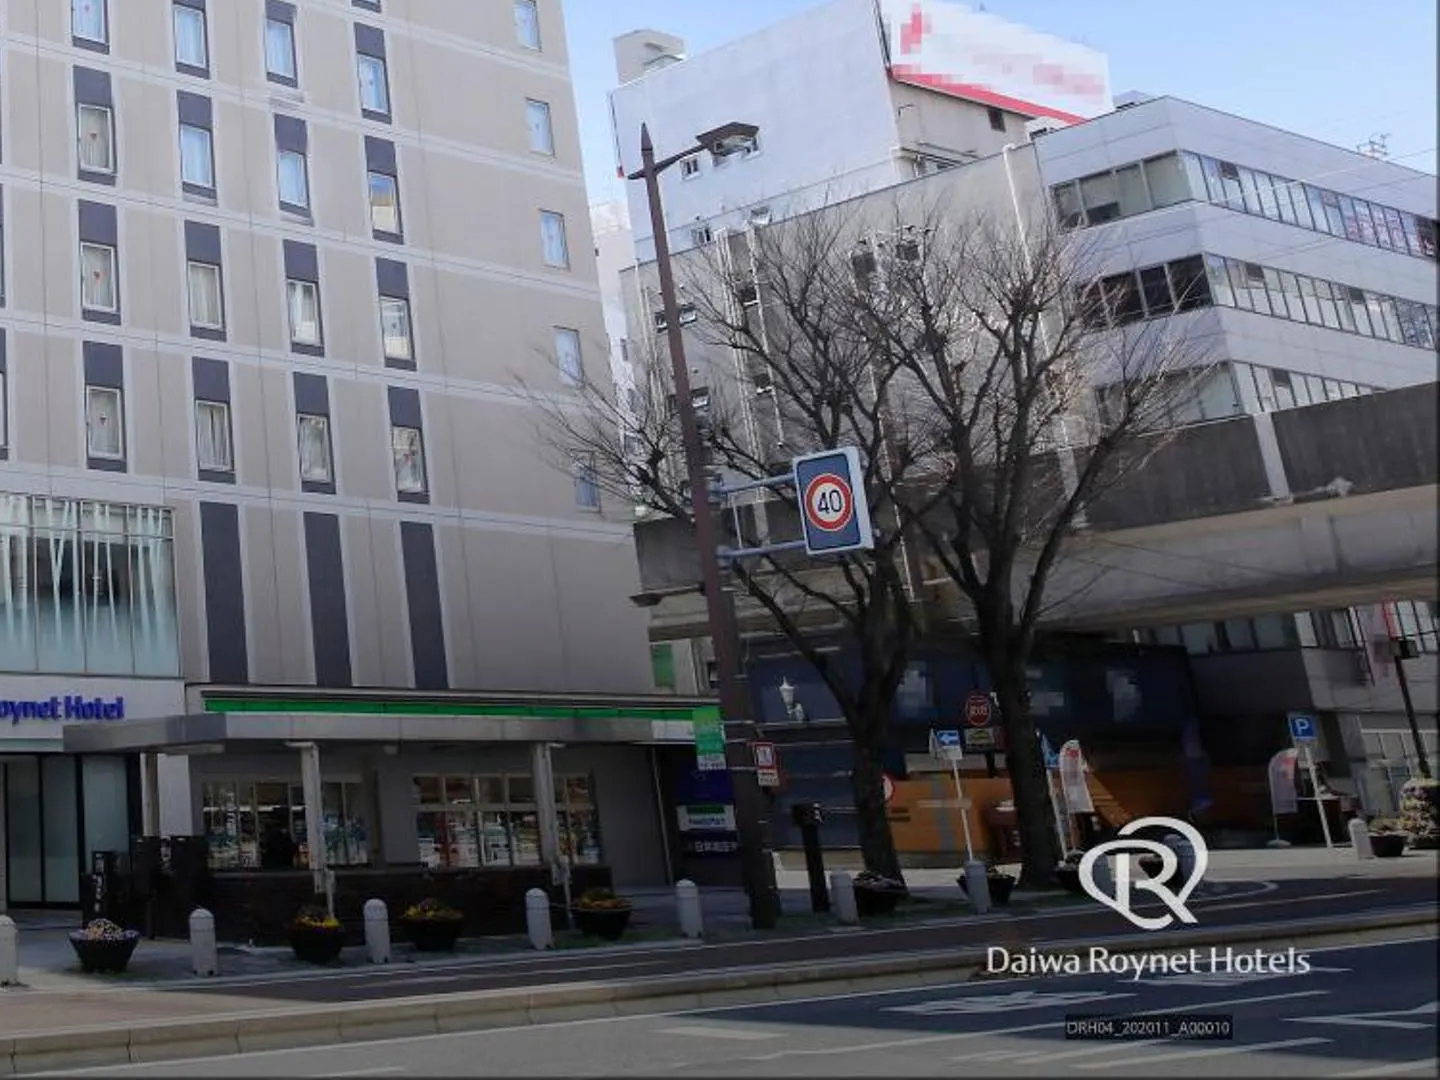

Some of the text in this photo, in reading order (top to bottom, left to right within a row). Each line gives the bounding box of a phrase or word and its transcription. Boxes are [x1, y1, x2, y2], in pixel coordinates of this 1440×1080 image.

[818, 490, 842, 513] 40
[64, 696, 125, 720] Hotel
[1295, 719, 1309, 735] P
